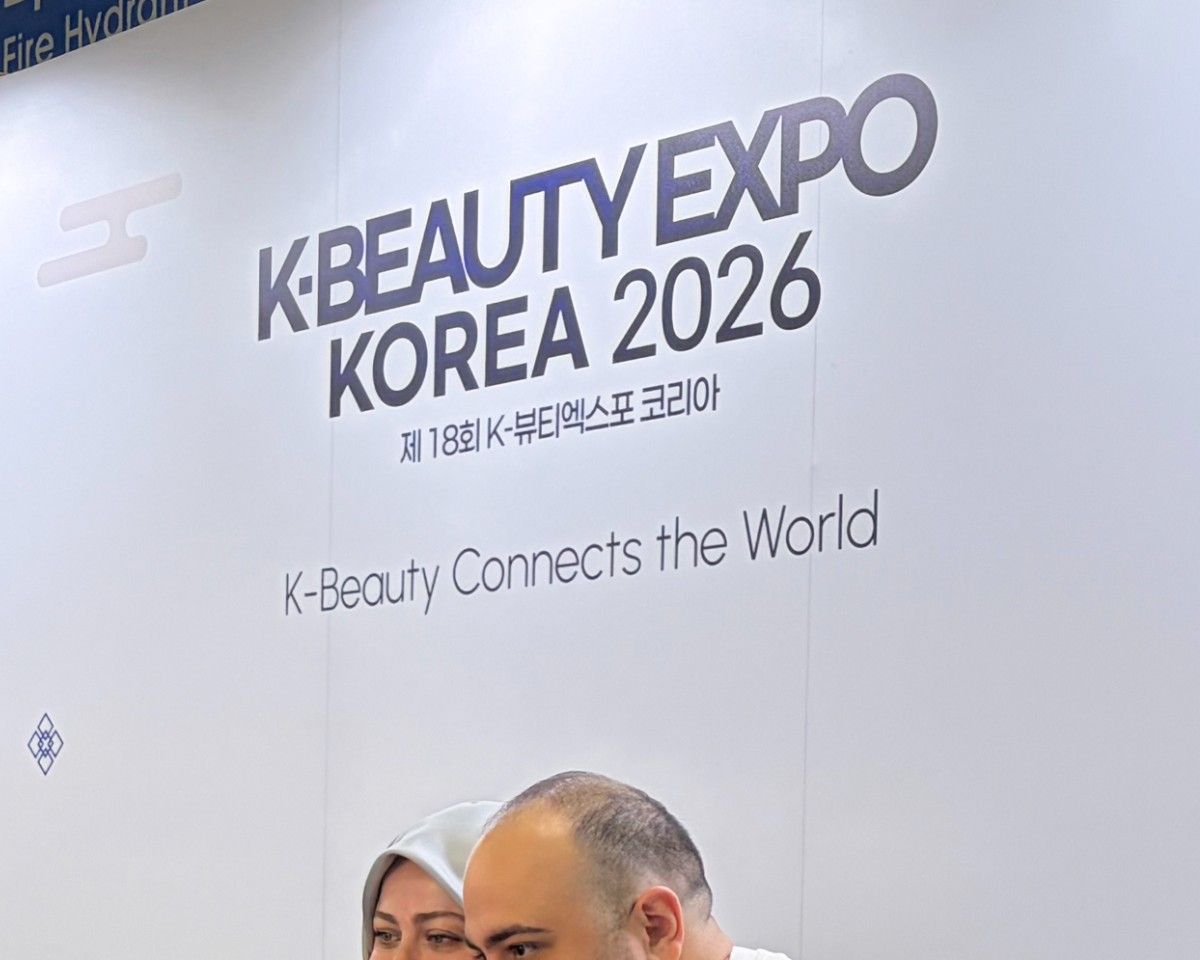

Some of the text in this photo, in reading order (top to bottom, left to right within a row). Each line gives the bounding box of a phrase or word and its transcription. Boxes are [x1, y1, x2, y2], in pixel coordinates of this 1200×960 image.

[3, 32, 54, 75] Fire
[257, 73, 938, 341] K-BEAUTY EXPO
[329, 230, 821, 418] KOREA 2026
[400, 373, 720, 463] 제 18회 K-뷰티엑스포 코리아
[286, 488, 879, 616] K-Beauty Connects the World
